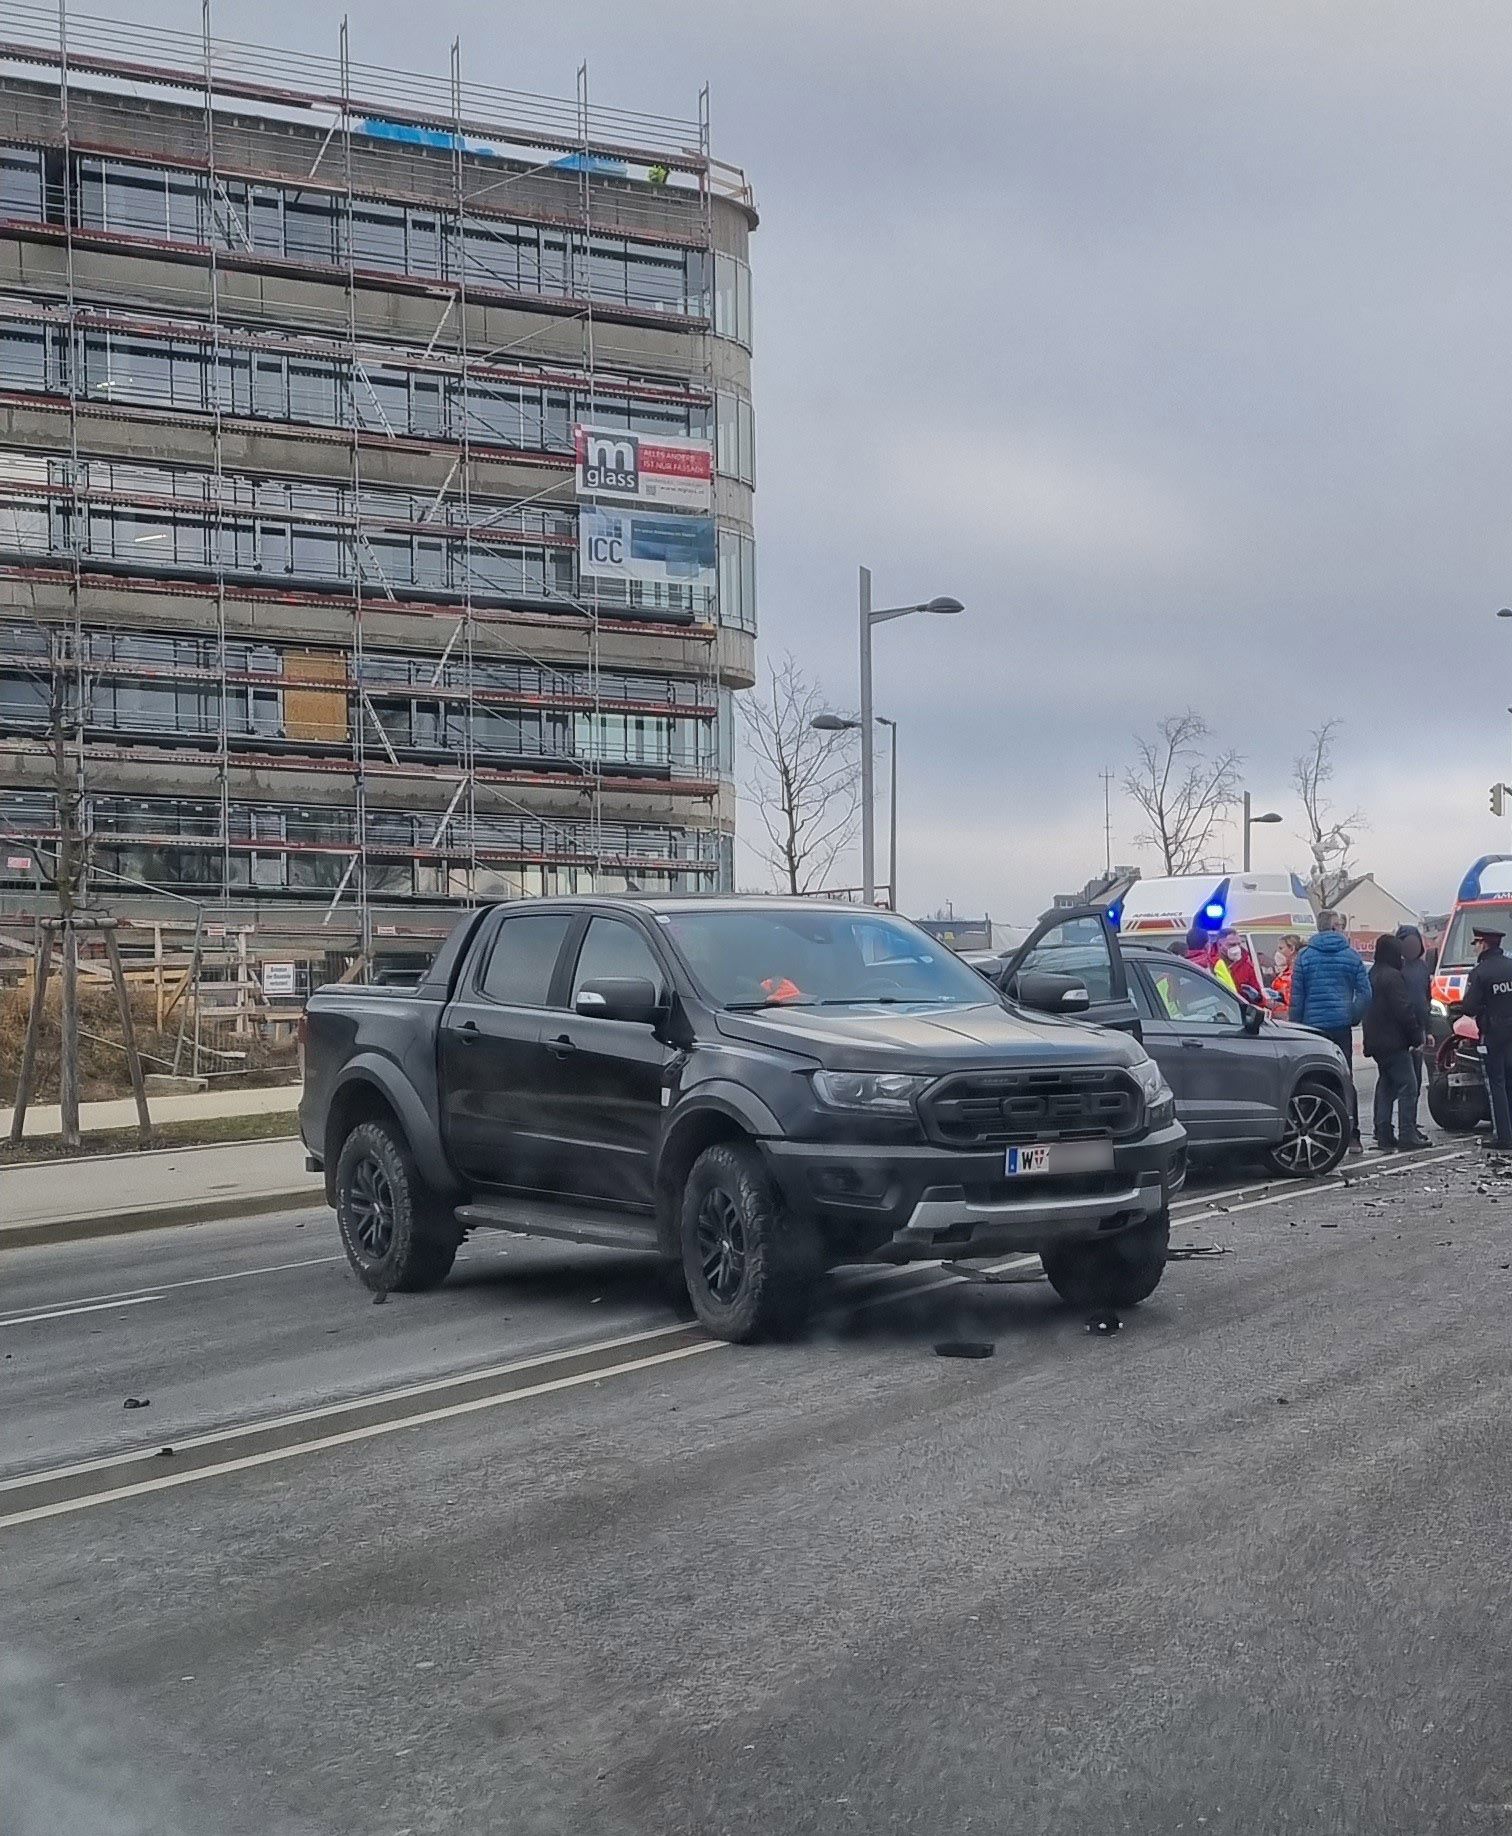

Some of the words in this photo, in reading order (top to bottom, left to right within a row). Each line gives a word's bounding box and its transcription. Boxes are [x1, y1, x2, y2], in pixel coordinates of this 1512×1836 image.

[587, 436, 635, 472] m
[587, 466, 635, 488] glass
[588, 536, 623, 564] ICC
